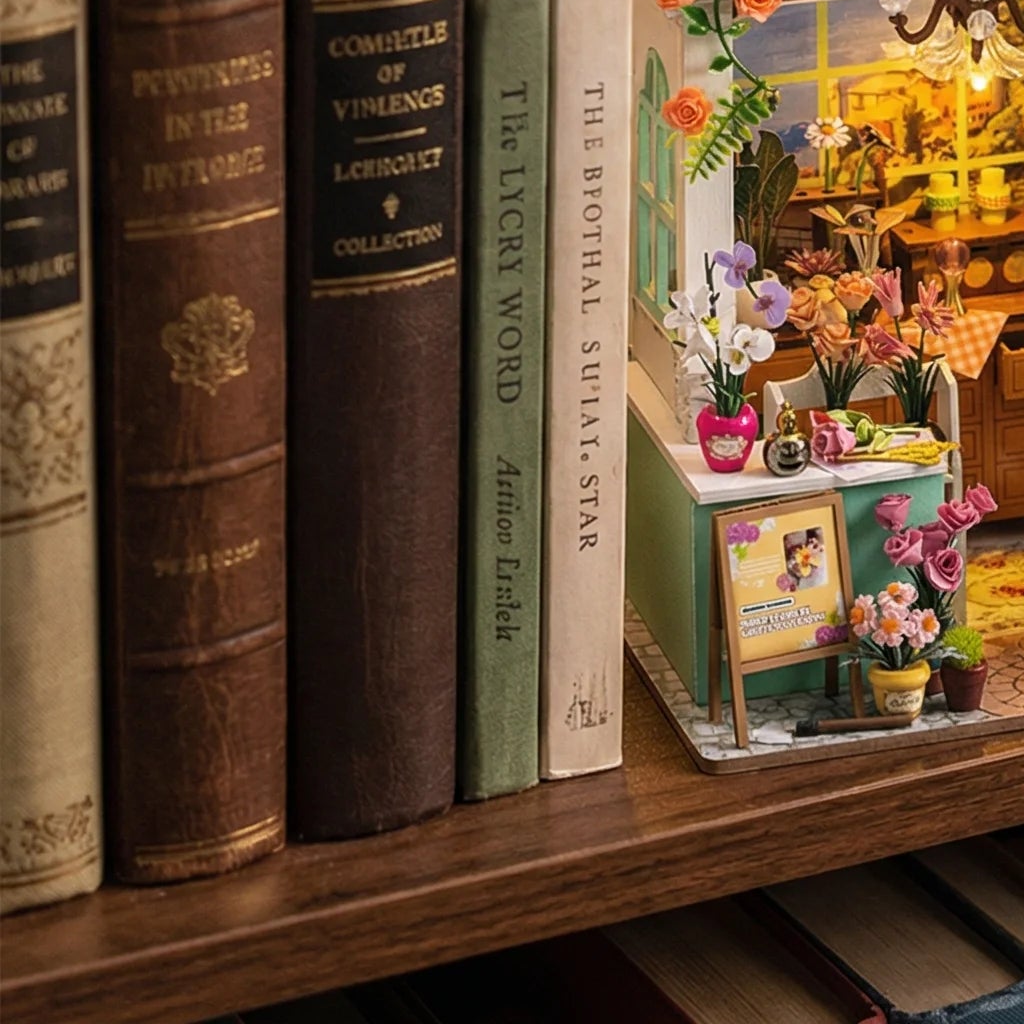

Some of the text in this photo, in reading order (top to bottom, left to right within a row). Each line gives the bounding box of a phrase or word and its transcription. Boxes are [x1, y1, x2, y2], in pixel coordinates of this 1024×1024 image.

[376, 61, 407, 84] OF
[583, 82, 605, 151] THE
[333, 221, 443, 256] COLLECTION
[498, 165, 525, 275] LYCRY
[496, 287, 523, 405] WORD
[578, 474, 600, 552] STAR
